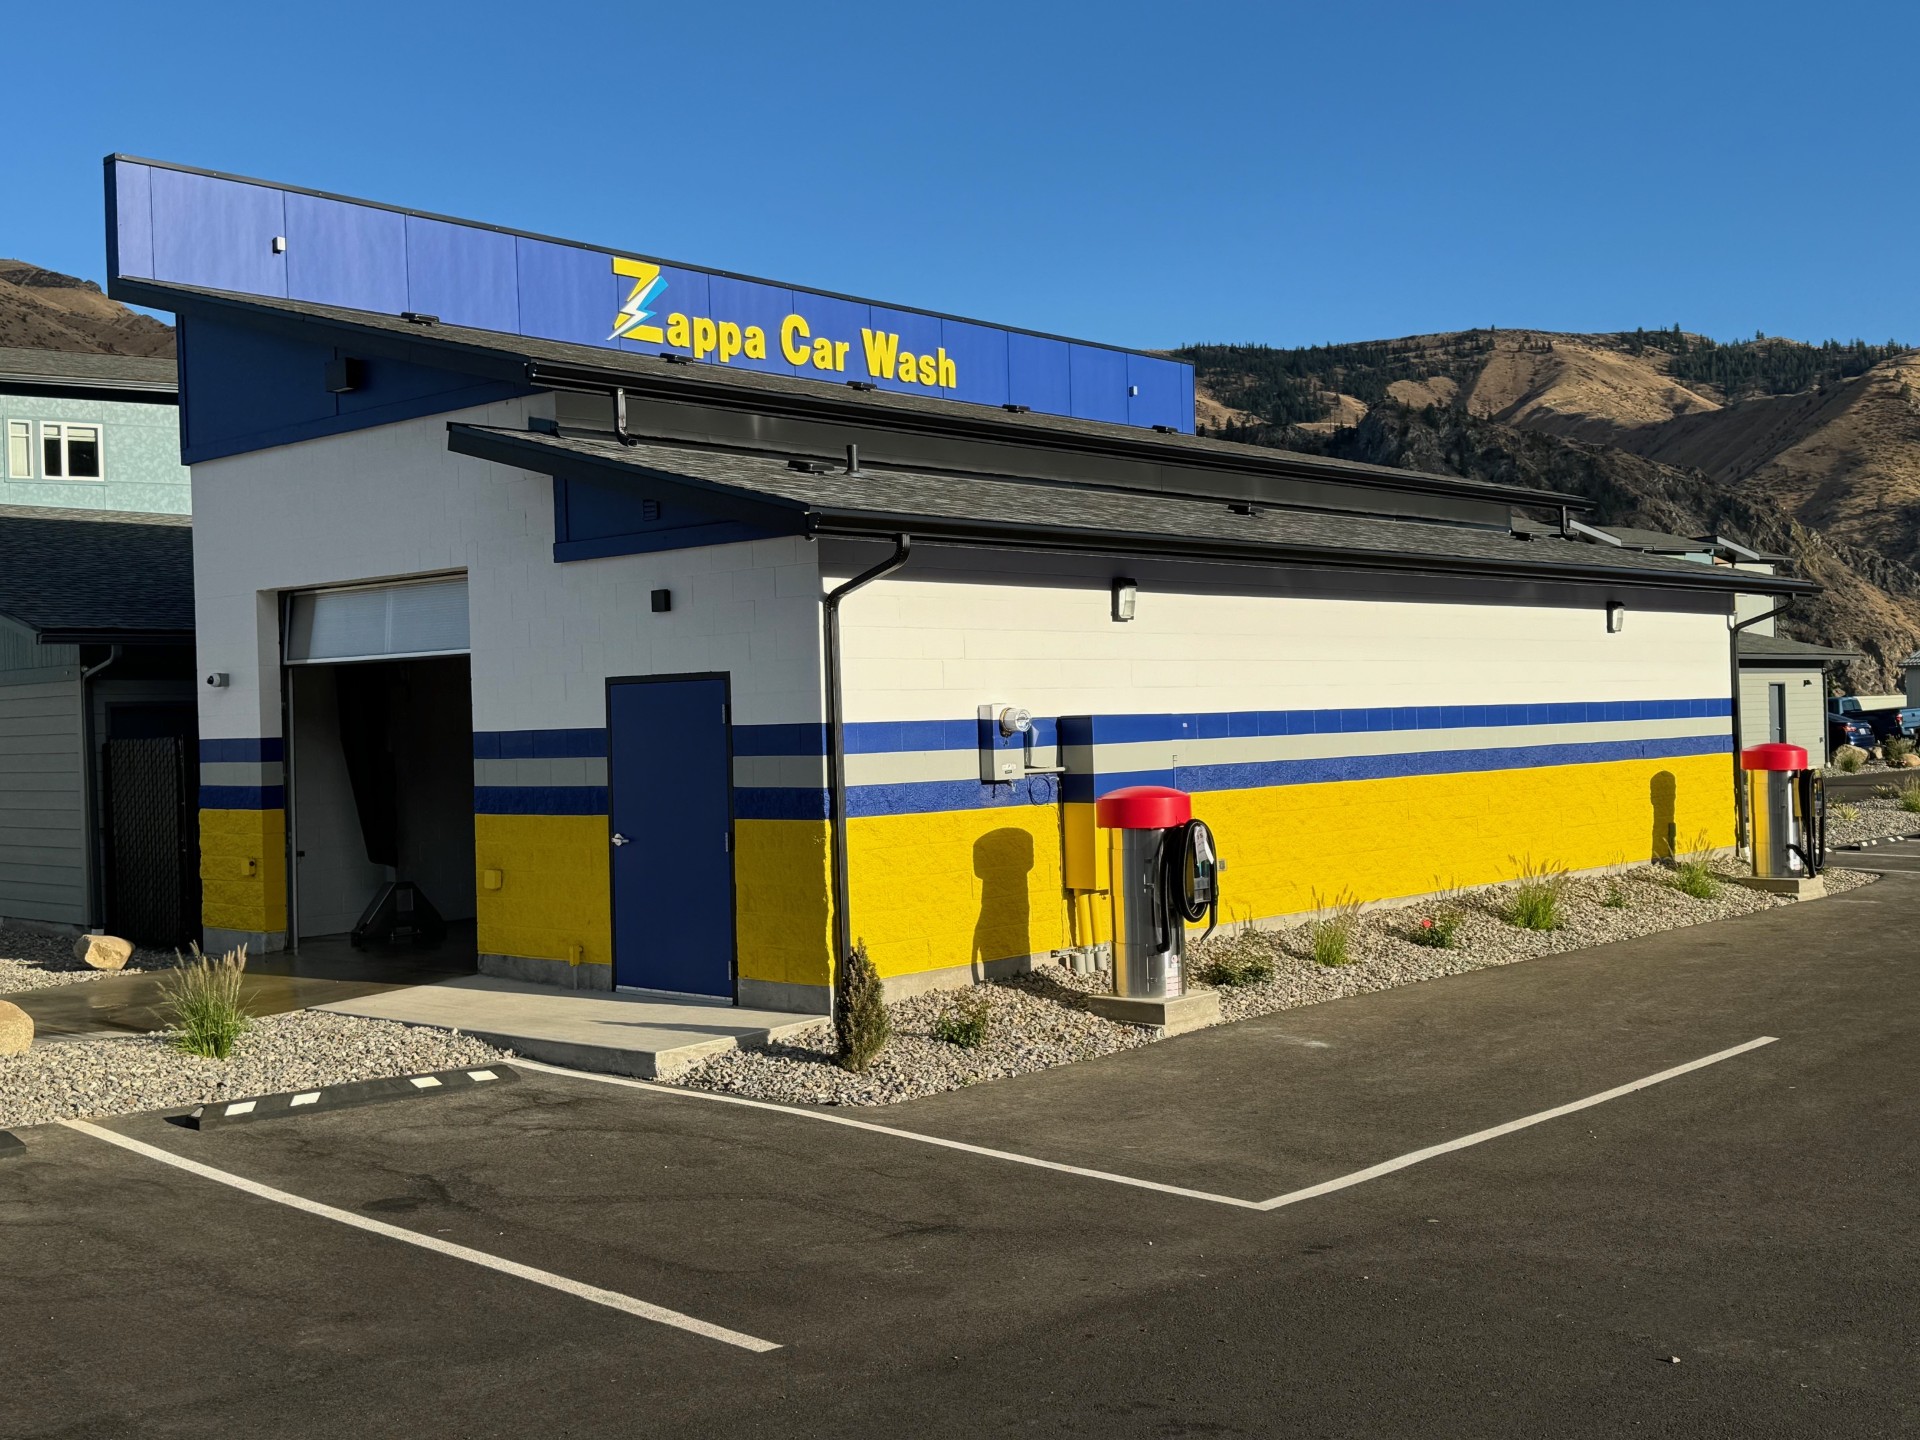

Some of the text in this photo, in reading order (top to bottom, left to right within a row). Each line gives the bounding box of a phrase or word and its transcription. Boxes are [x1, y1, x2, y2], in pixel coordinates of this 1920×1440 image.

[610, 256, 957, 389] Zappa Car Wash
